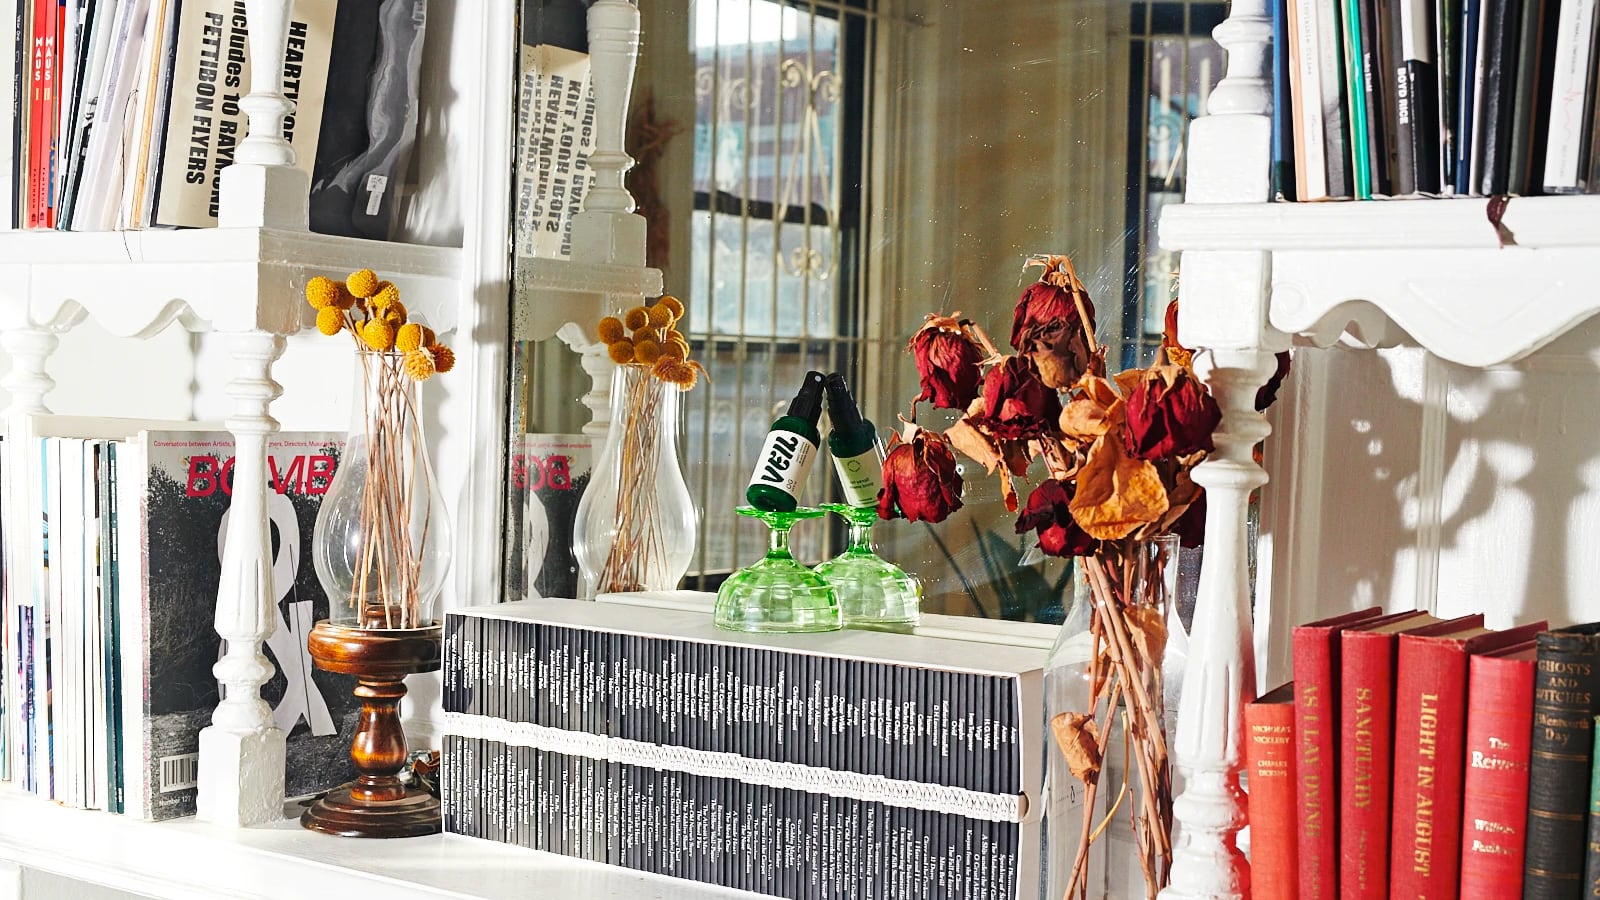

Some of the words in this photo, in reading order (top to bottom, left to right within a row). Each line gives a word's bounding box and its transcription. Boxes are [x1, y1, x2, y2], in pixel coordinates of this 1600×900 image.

[35, 36, 44, 81] MAUS
[44, 36, 54, 81] MAUS
[225, 0, 248, 87] ncludes
[194, 12, 224, 111] PETTIBON
[1397, 67, 1408, 98] BOYD
[222, 93, 240, 116] 10
[1399, 98, 1409, 125] RICE
[186, 115, 212, 185] FLYERS
[153, 440, 188, 448] Conversations
[188, 440, 212, 448] between
[212, 440, 232, 448] Artists,
[1538, 660, 1592, 676] GHOSTS
[1549, 677, 1578, 688] AND
[1304, 684, 1320, 708] AS
[1418, 692, 1439, 760] LIGHT
[1545, 728, 1570, 745] Day
[1304, 729, 1320, 766] LAY
[1355, 688, 1373, 809] SANCTUARY
[1488, 737, 1510, 750] The
[1418, 765, 1436, 789] IN
[1414, 792, 1434, 878] AUGUST
